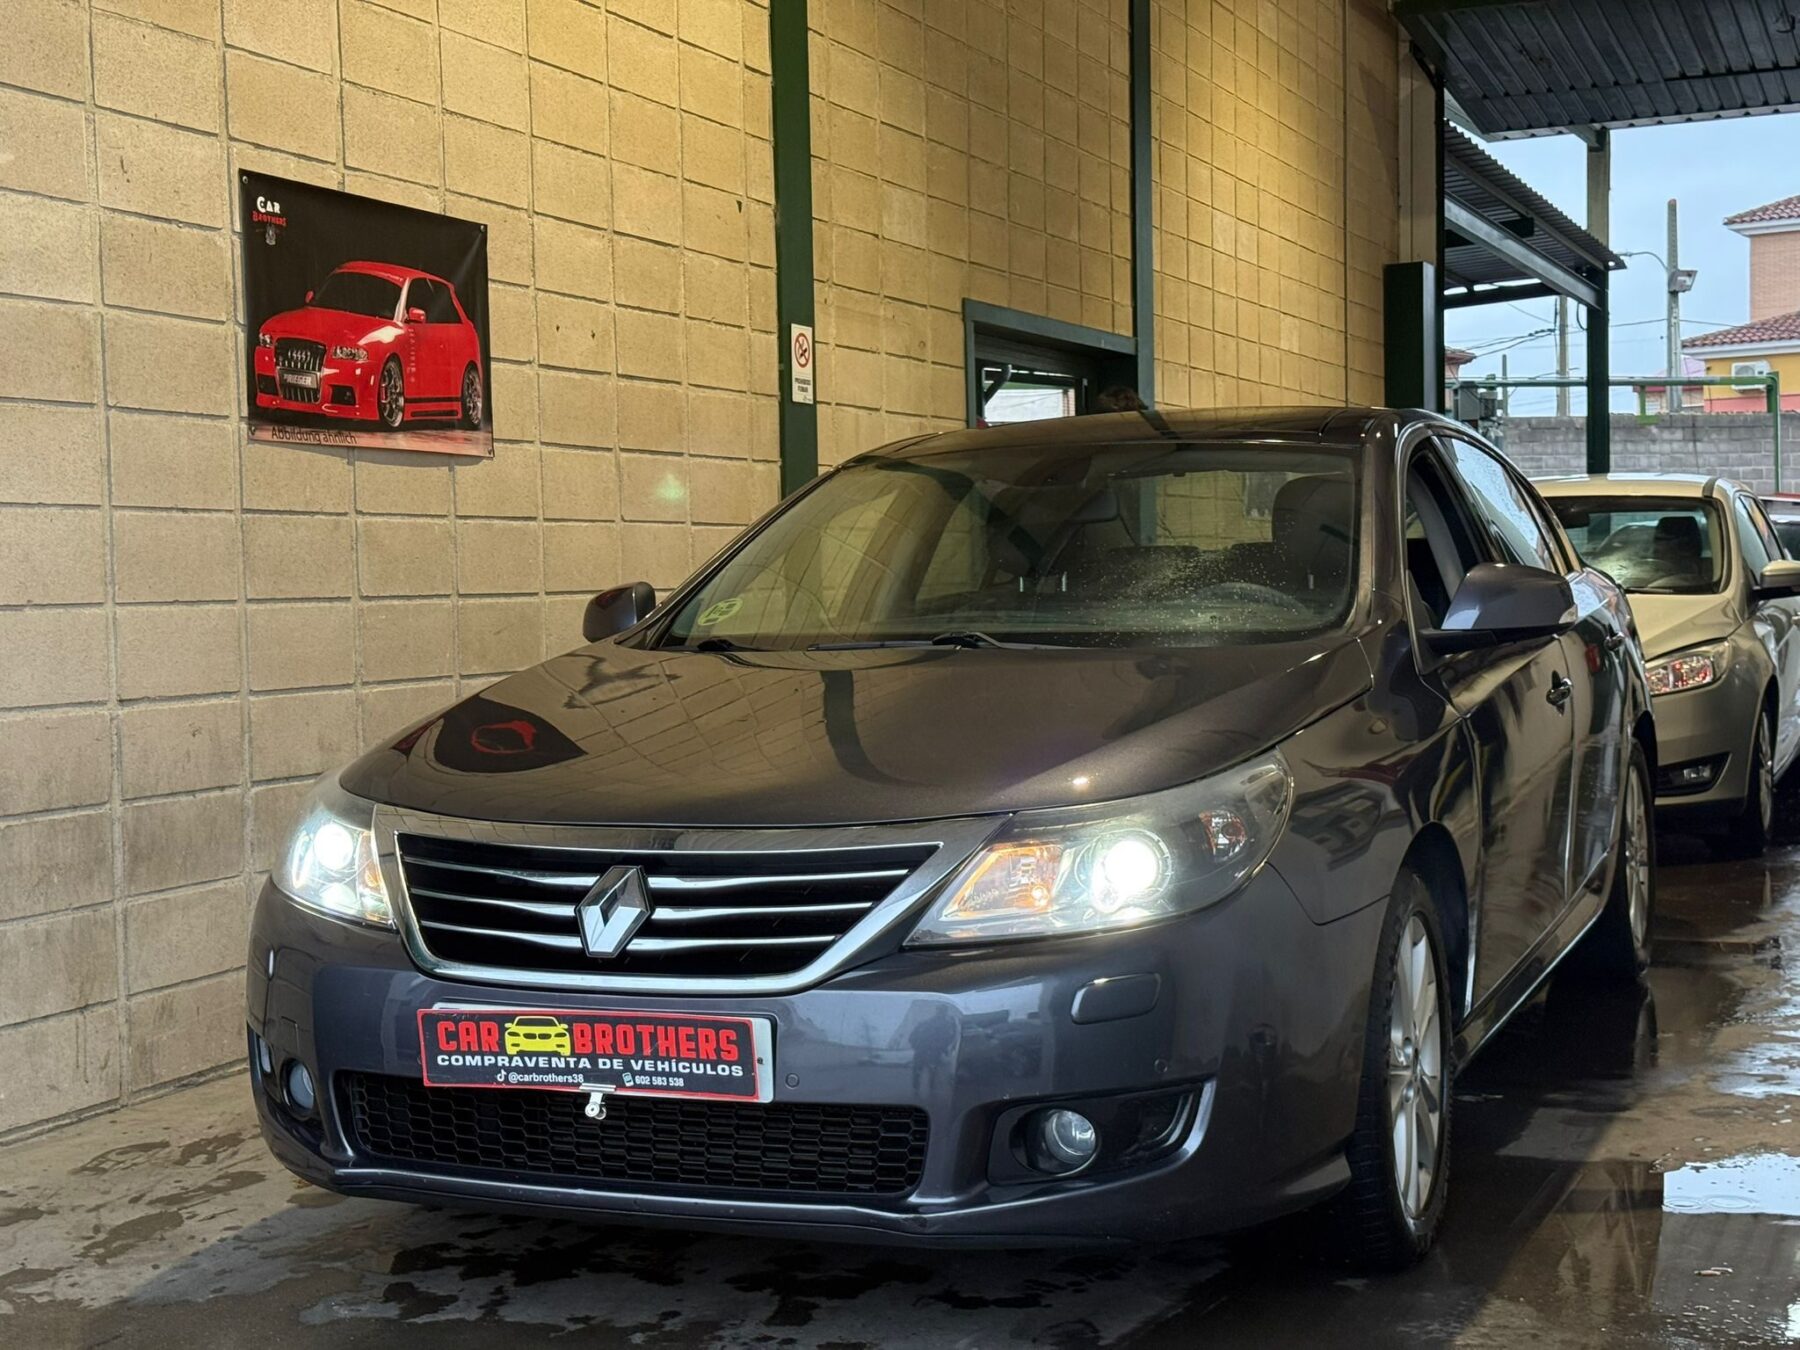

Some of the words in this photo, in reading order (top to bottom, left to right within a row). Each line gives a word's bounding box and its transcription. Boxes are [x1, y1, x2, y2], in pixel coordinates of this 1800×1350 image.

[271, 425, 320, 442] Abbildung
[437, 1020, 500, 1053] CAR
[573, 1022, 739, 1062] BROTHERS
[436, 1054, 592, 1069] COMPRAVENTA
[598, 1058, 624, 1070] DE
[630, 1058, 744, 1077] VEHÍCULOS
[508, 1071, 585, 1084] @carbrothers38
[635, 1075, 650, 1086] 602
[651, 1076, 667, 1087] 583
[668, 1077, 684, 1088] 538
